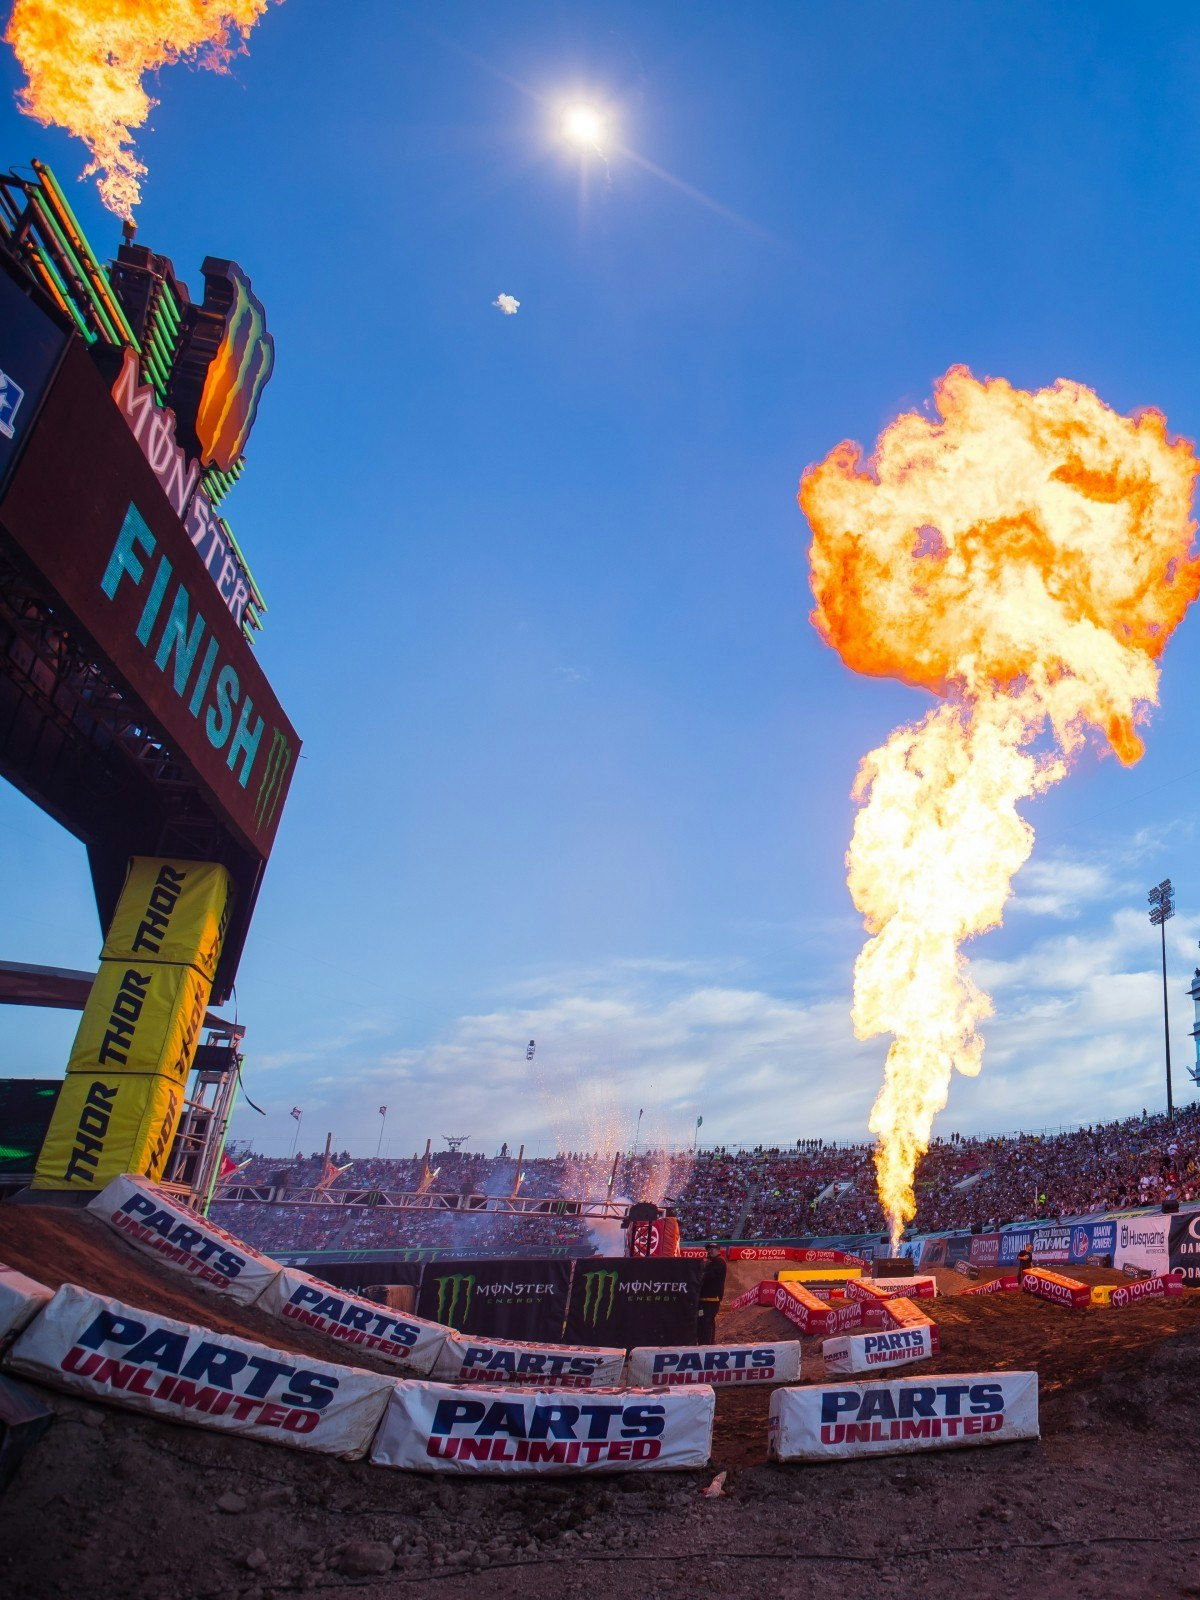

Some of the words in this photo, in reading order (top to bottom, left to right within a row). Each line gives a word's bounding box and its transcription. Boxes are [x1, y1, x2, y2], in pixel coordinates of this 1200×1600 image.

[100, 500, 264, 789] FINISH
[131, 864, 187, 954] THOR
[98, 968, 152, 1066] THOR
[63, 1080, 118, 1182] THOR
[110, 1210, 231, 1289] UNLIMITED
[121, 1193, 246, 1278] PARTS
[1130, 1230, 1164, 1248] Husqvarna
[1041, 1280, 1073, 1300] TOYOTA
[1130, 1278, 1164, 1296] TOYOTA
[289, 1284, 420, 1346] PARTS
[785, 1293, 809, 1322] TOYOTA
[839, 1302, 862, 1321] TOYOTA
[282, 1303, 411, 1358] UNLIMITED
[864, 1330, 924, 1354] PARTS
[77, 1310, 340, 1410] PARTS
[462, 1348, 595, 1376] PARTS
[653, 1349, 776, 1372] PARTS
[865, 1345, 925, 1365] UNLIMITED
[60, 1347, 322, 1435] UNLIMITED
[459, 1367, 592, 1388] UNLIMITED
[652, 1367, 774, 1385] UNLIMITED
[431, 1400, 666, 1439] PARTS
[821, 1383, 1004, 1424] PARTS
[820, 1413, 1003, 1446] UNLIMITED
[426, 1436, 662, 1464] UNLIMITED
